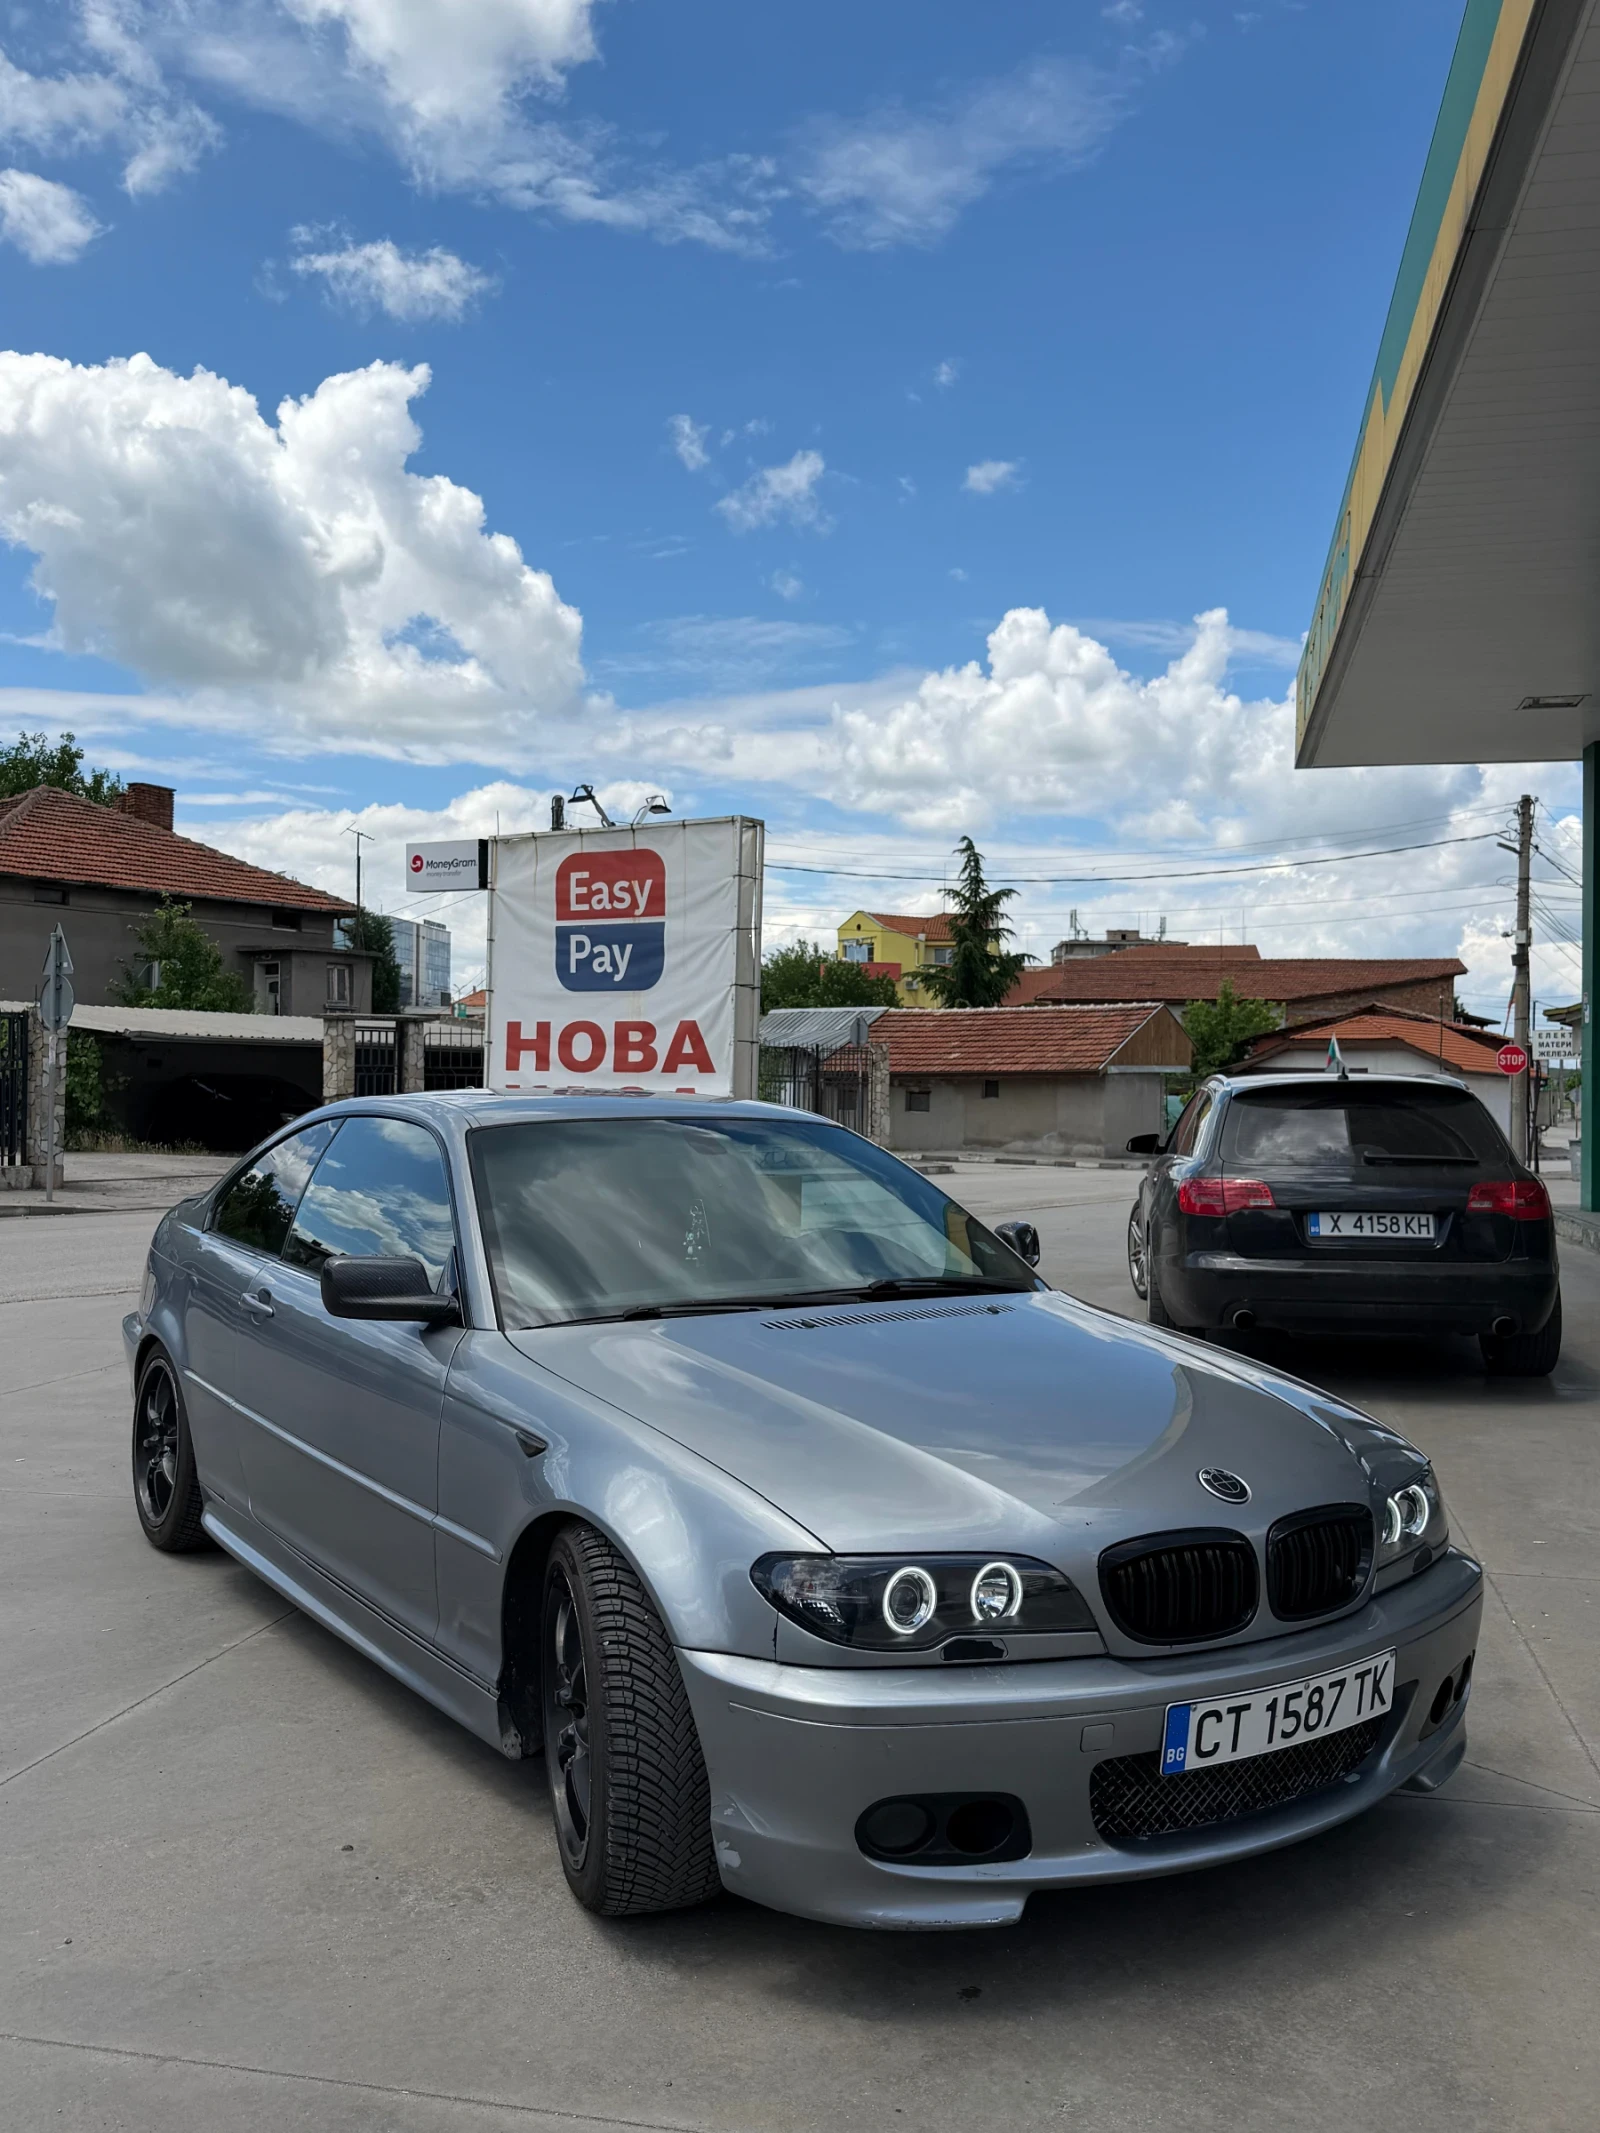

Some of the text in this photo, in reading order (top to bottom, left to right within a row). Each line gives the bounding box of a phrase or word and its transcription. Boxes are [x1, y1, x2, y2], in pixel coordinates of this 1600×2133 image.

[569, 869, 653, 916] Easy
[569, 934, 633, 982] Pay
[505, 1019, 717, 1074] НОВА
[1500, 1054, 1524, 1065] STOP
[1329, 1214, 1342, 1233] X
[1352, 1215, 1400, 1234] 4158
[1404, 1216, 1431, 1235] KH
[1166, 1659, 1390, 1764] BG CT 1587 TK
